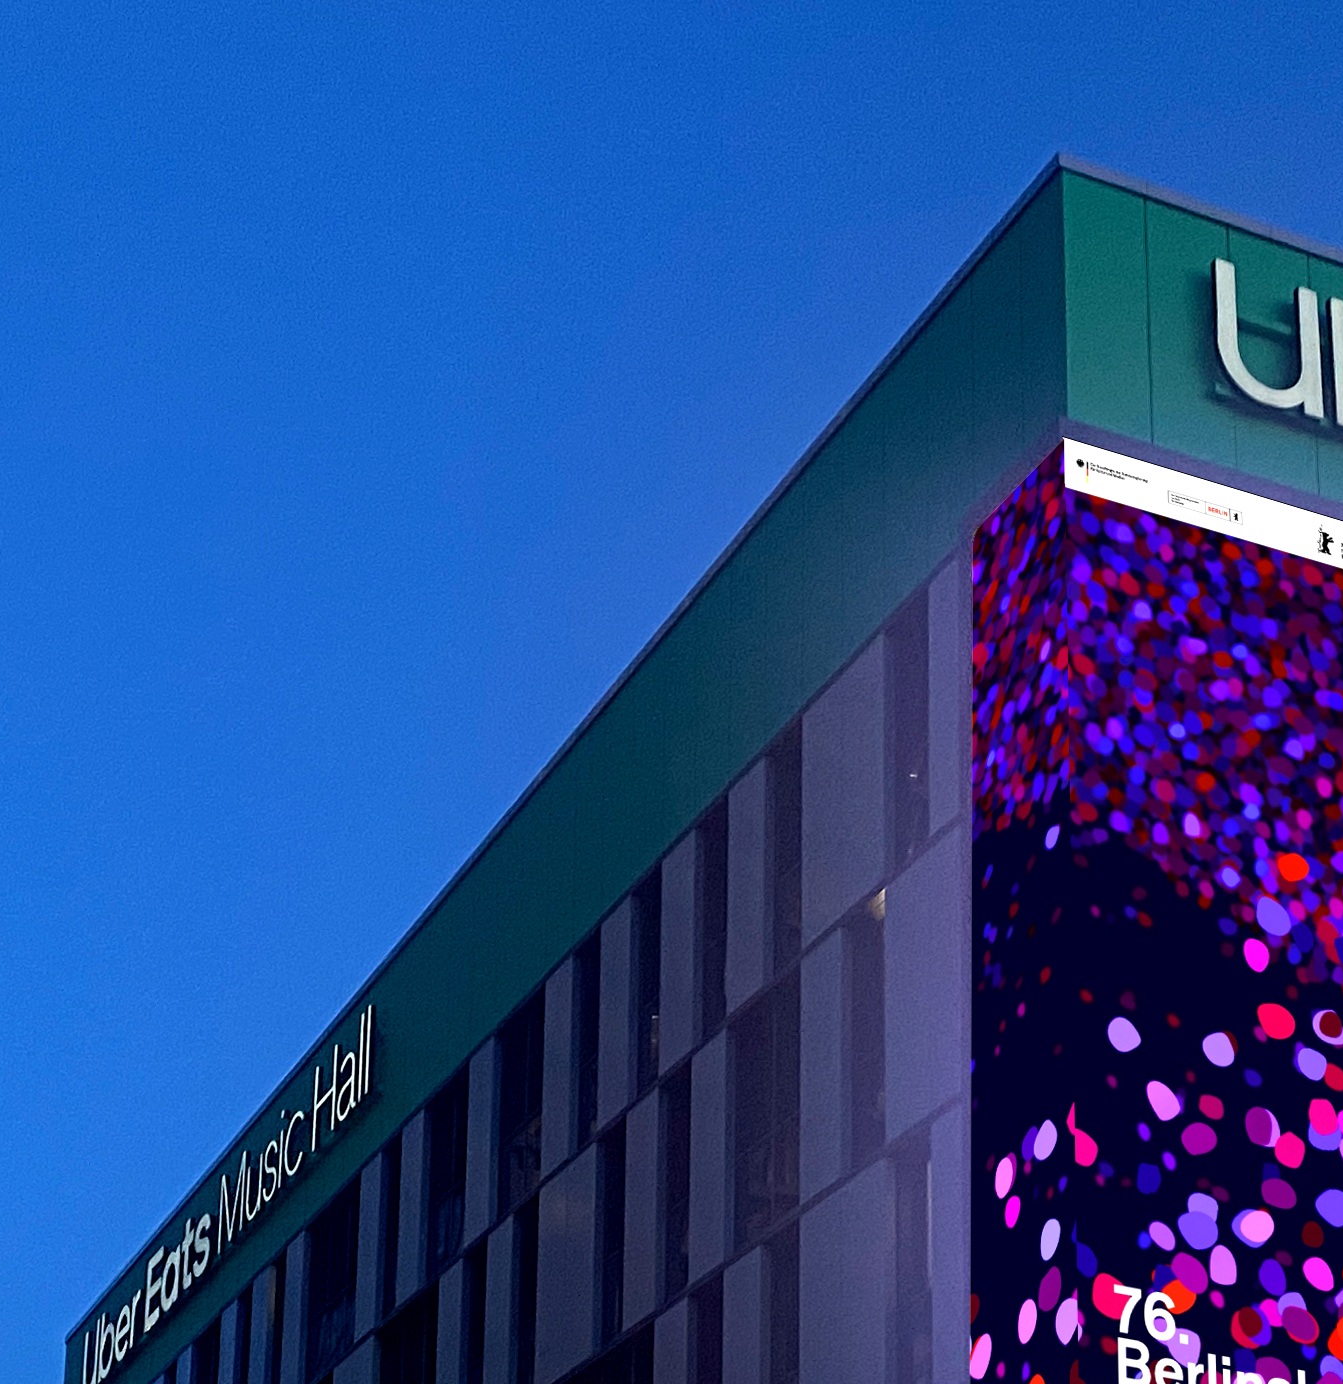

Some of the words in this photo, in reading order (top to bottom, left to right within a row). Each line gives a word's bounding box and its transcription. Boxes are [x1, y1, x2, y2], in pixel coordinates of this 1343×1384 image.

[1208, 506, 1228, 516] BERLIN
[144, 1214, 210, 1332] Eats
[217, 1110, 304, 1254] Music
[311, 1004, 372, 1151] Hall
[1113, 1284, 1189, 1345] 76.
